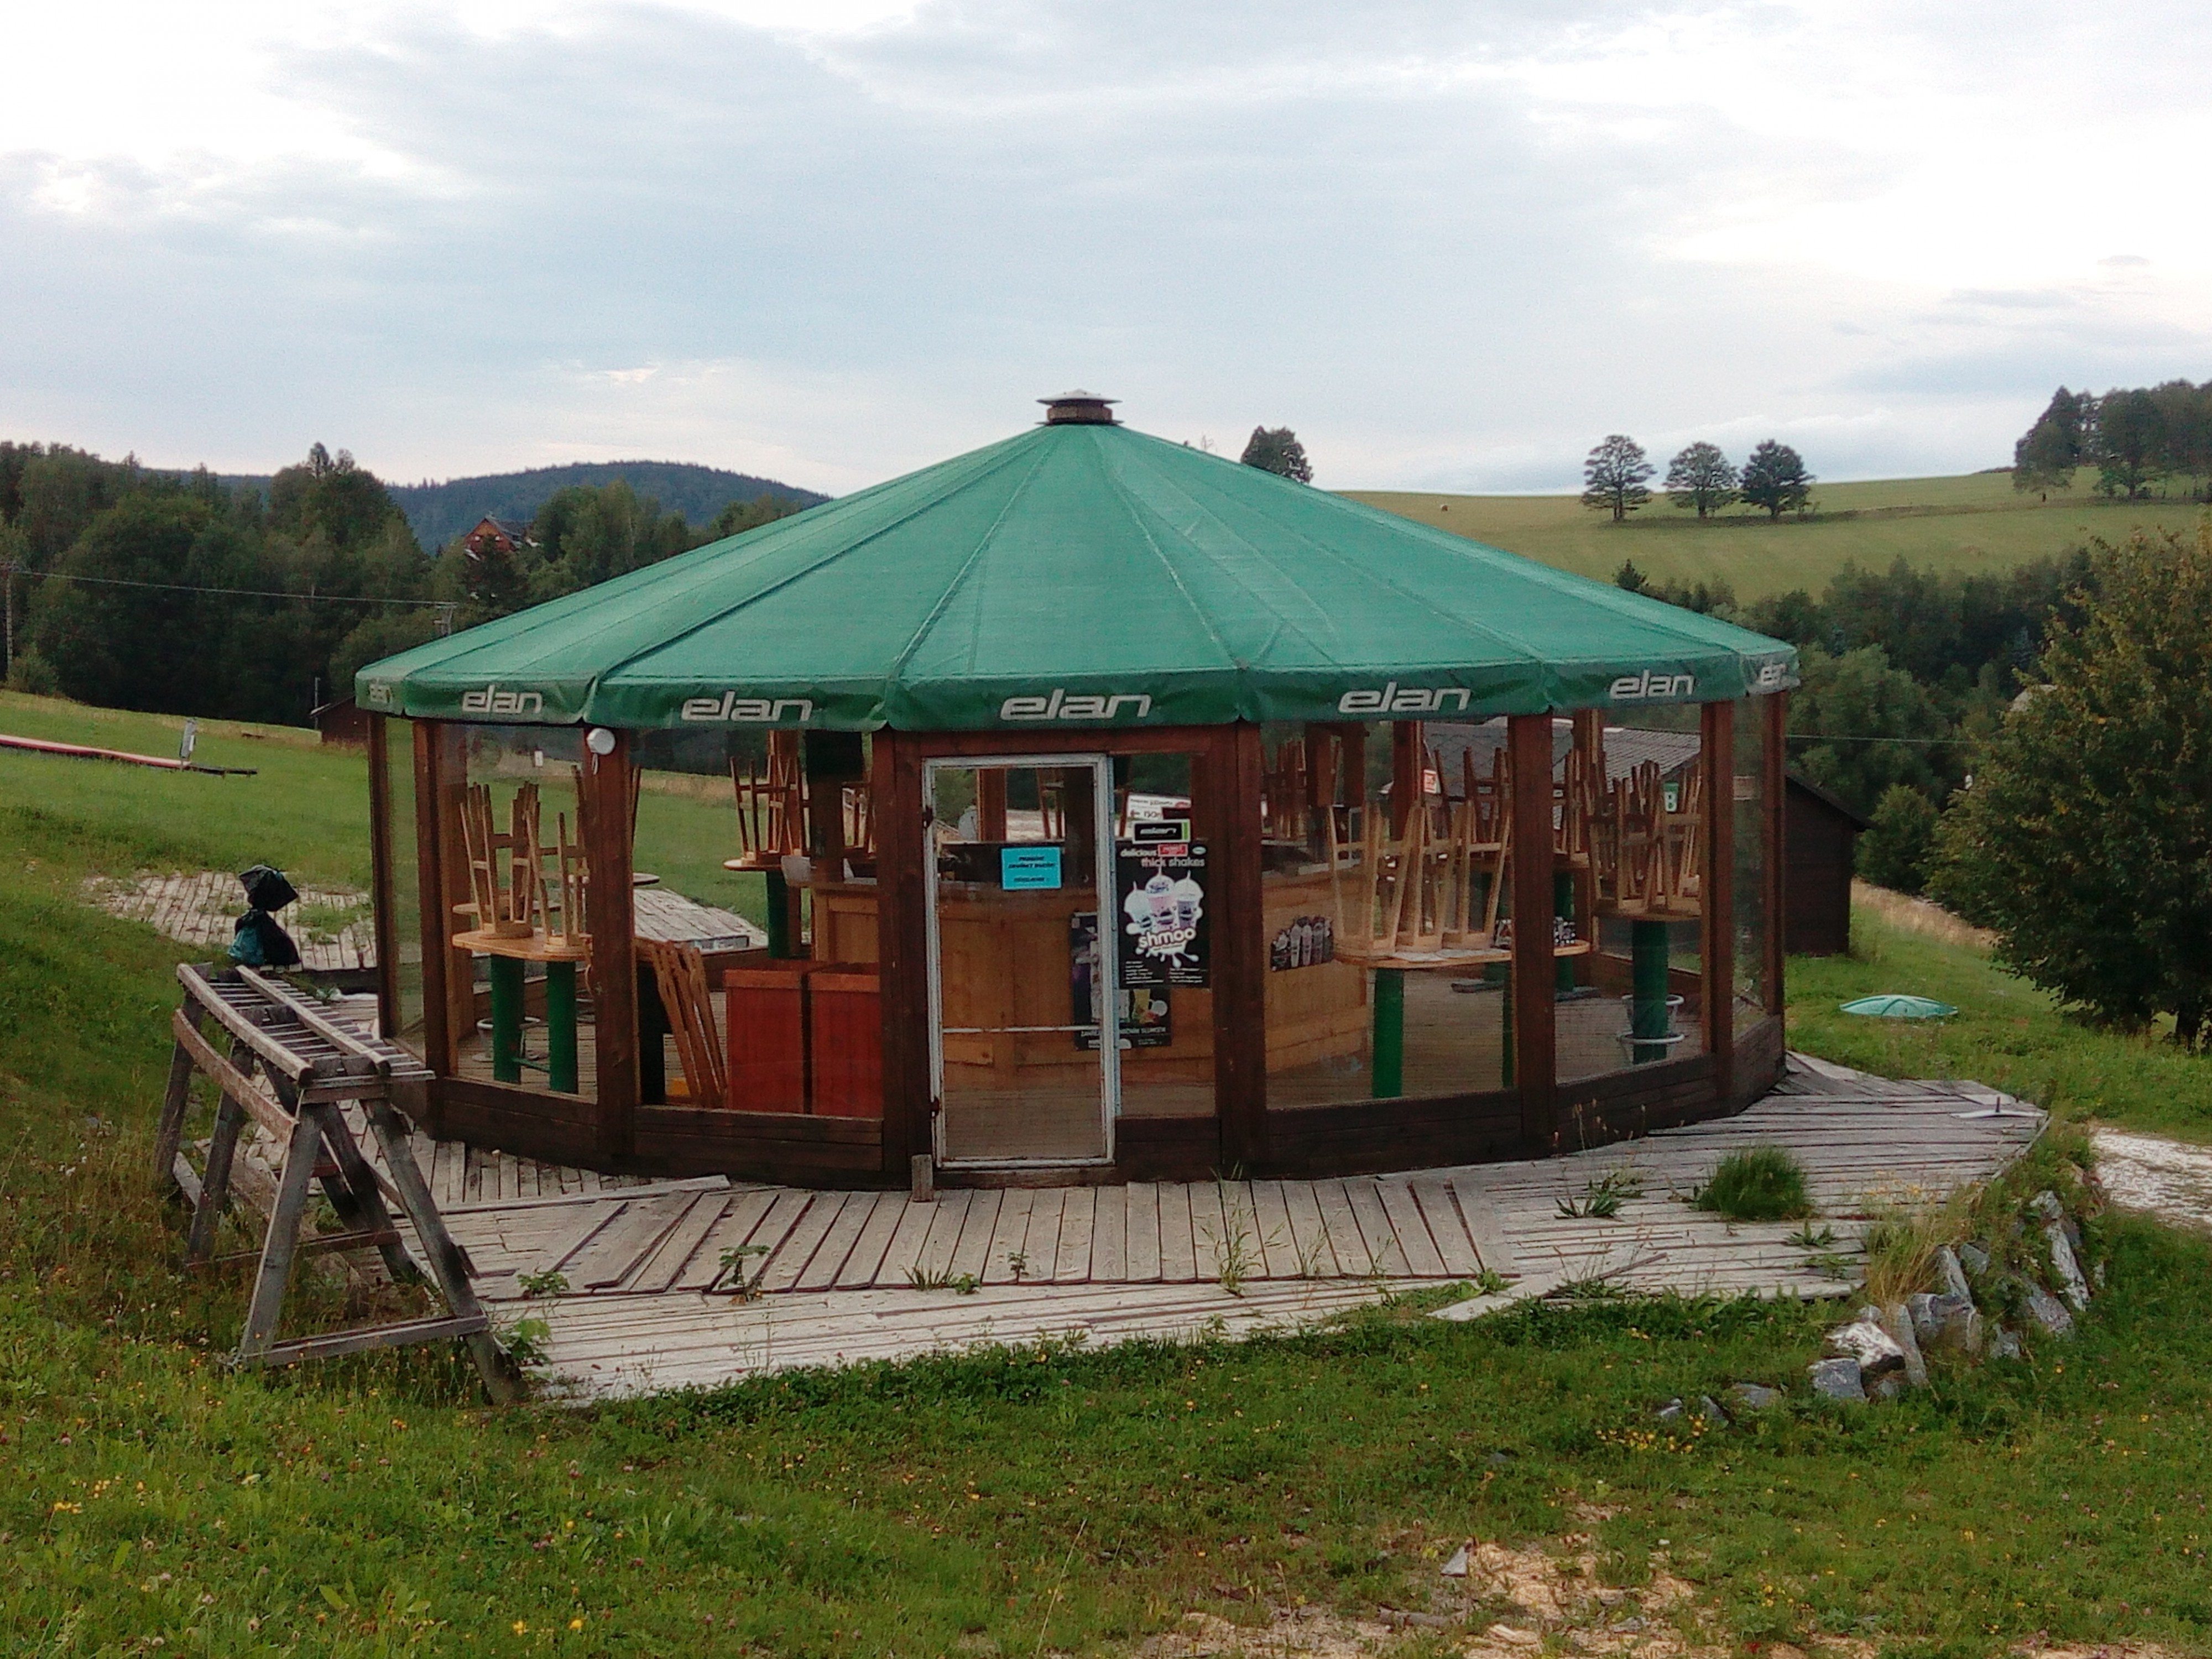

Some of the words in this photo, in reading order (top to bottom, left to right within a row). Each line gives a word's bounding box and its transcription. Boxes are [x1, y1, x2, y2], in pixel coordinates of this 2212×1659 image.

[462, 684, 542, 714] elan
[1338, 681, 1472, 713] elan
[1609, 669, 1694, 700] elan
[681, 690, 813, 722] elan
[1000, 688, 1152, 721] elan
[1141, 857, 1167, 868] thick
[1168, 857, 1205, 867] shakes
[1138, 927, 1197, 949] shmoo
